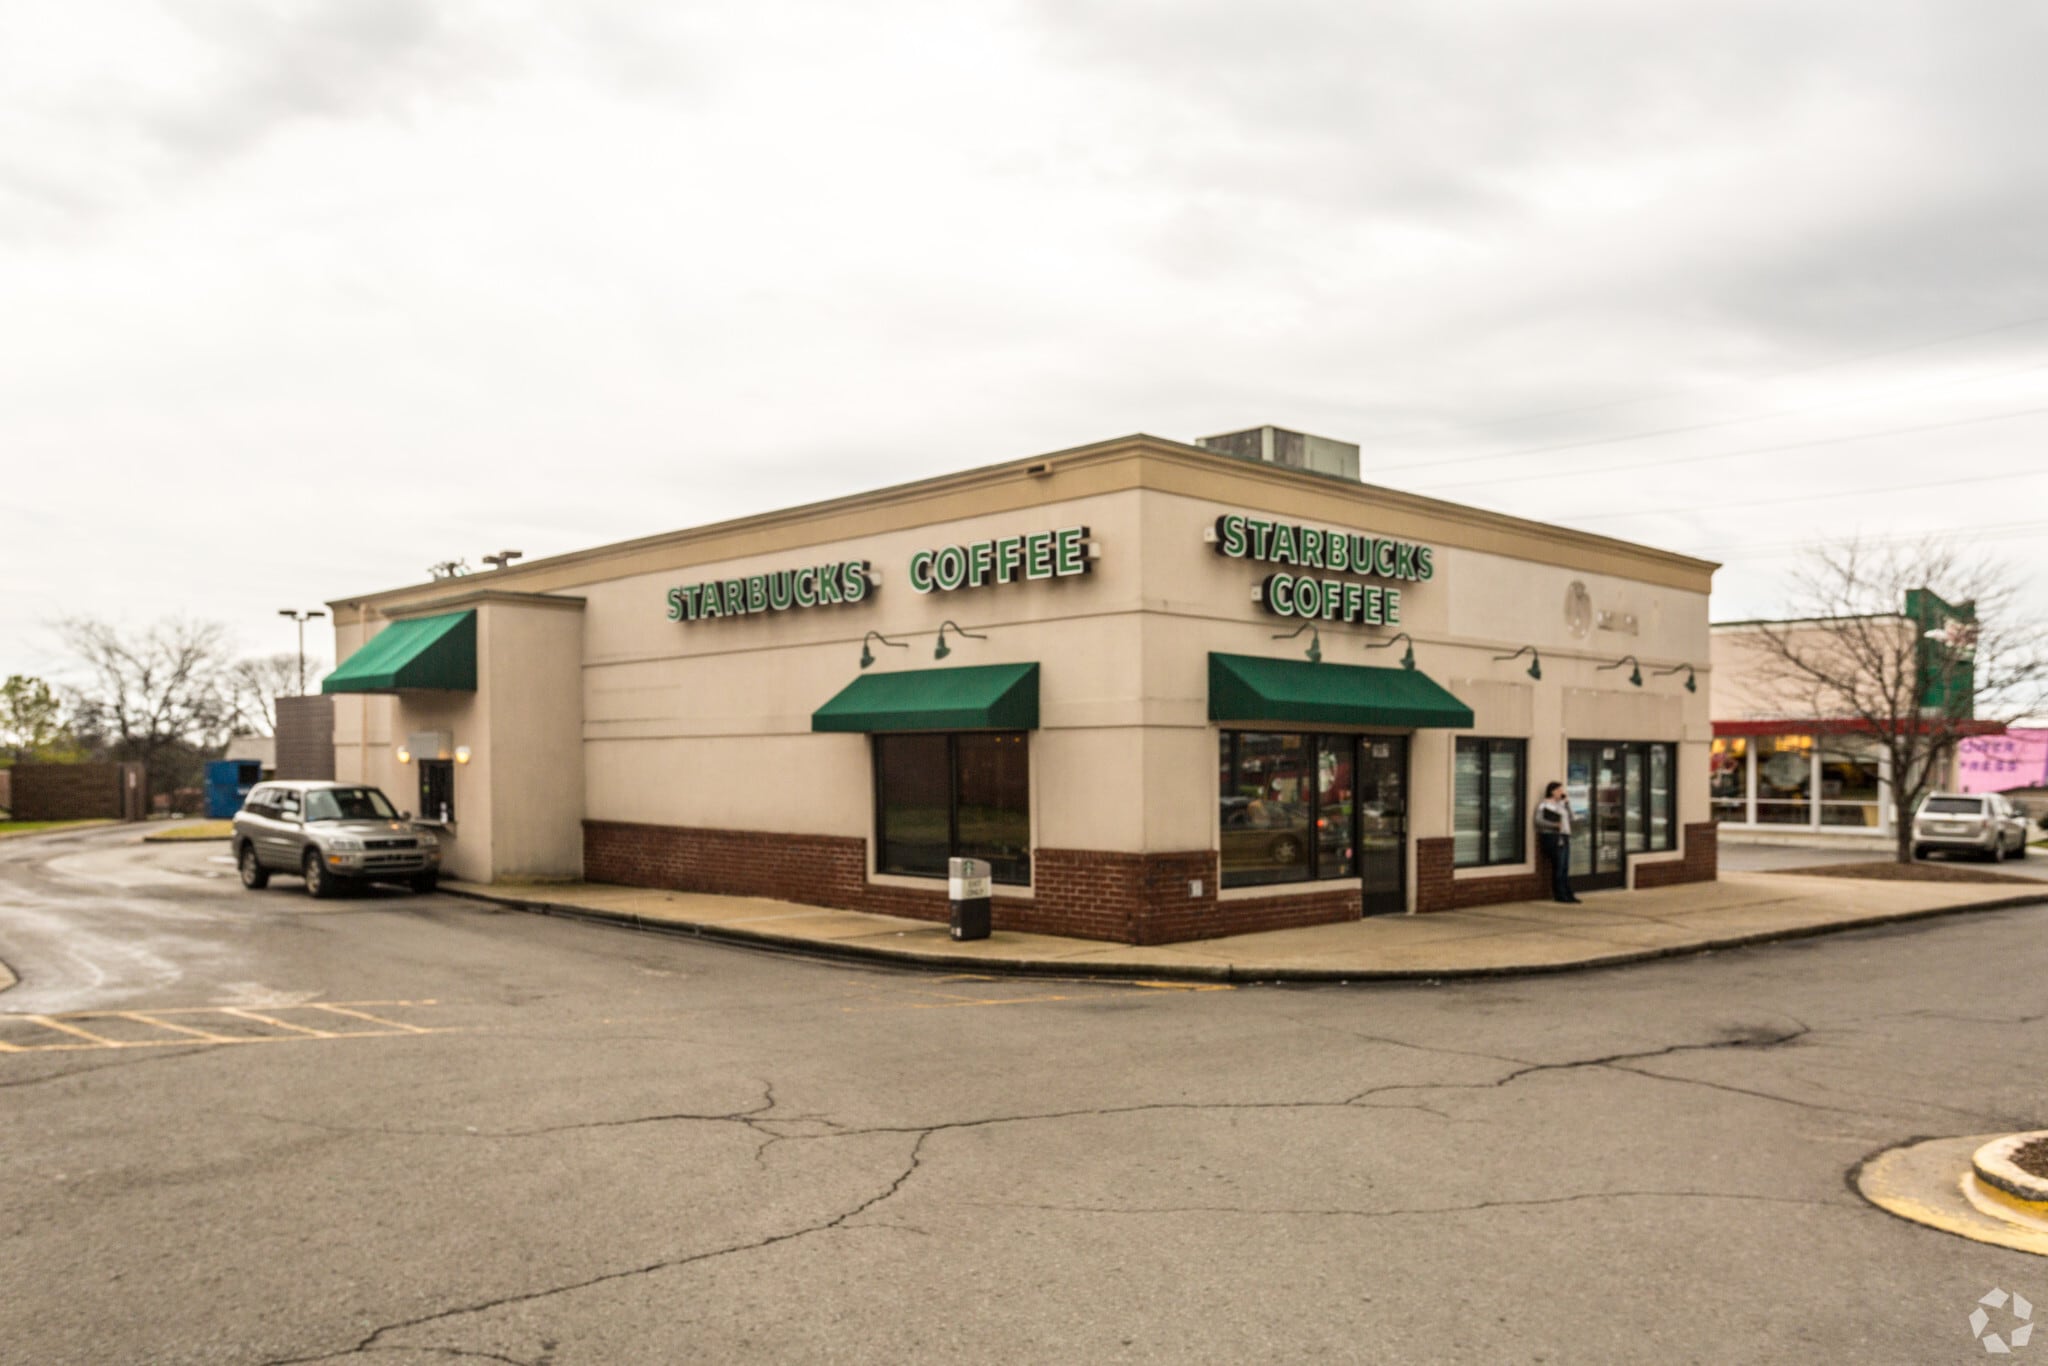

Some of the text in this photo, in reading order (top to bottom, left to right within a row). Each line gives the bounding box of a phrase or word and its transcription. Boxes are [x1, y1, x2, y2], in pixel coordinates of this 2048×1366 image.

[666, 526, 1084, 622] STARBUCKS COFFEE
[1224, 515, 1434, 583] STARBUCKS
[1270, 572, 1401, 626] COFFEE
